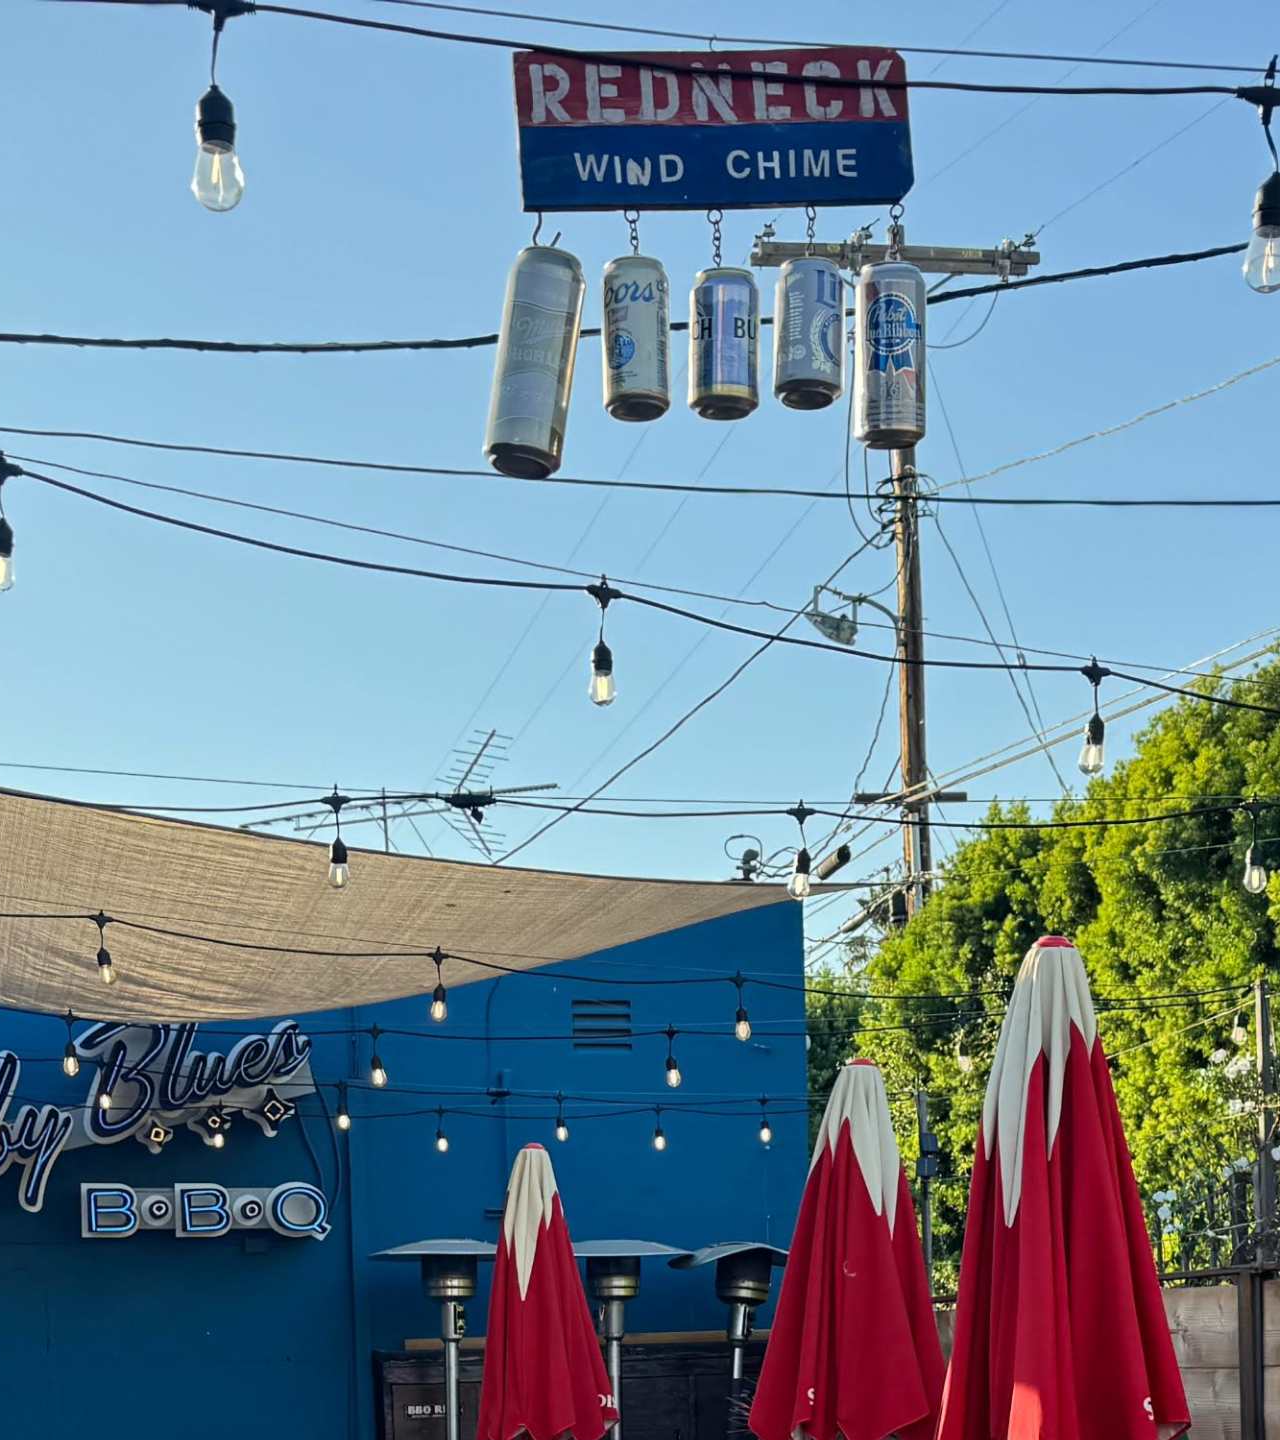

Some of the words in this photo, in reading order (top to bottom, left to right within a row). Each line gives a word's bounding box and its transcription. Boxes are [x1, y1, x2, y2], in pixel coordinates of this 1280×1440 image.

[528, 58, 899, 124] REDNECK
[573, 151, 684, 187] WIND
[725, 148, 859, 180] CHIME
[604, 279, 656, 308] oors
[74, 1019, 312, 1145] Blues
